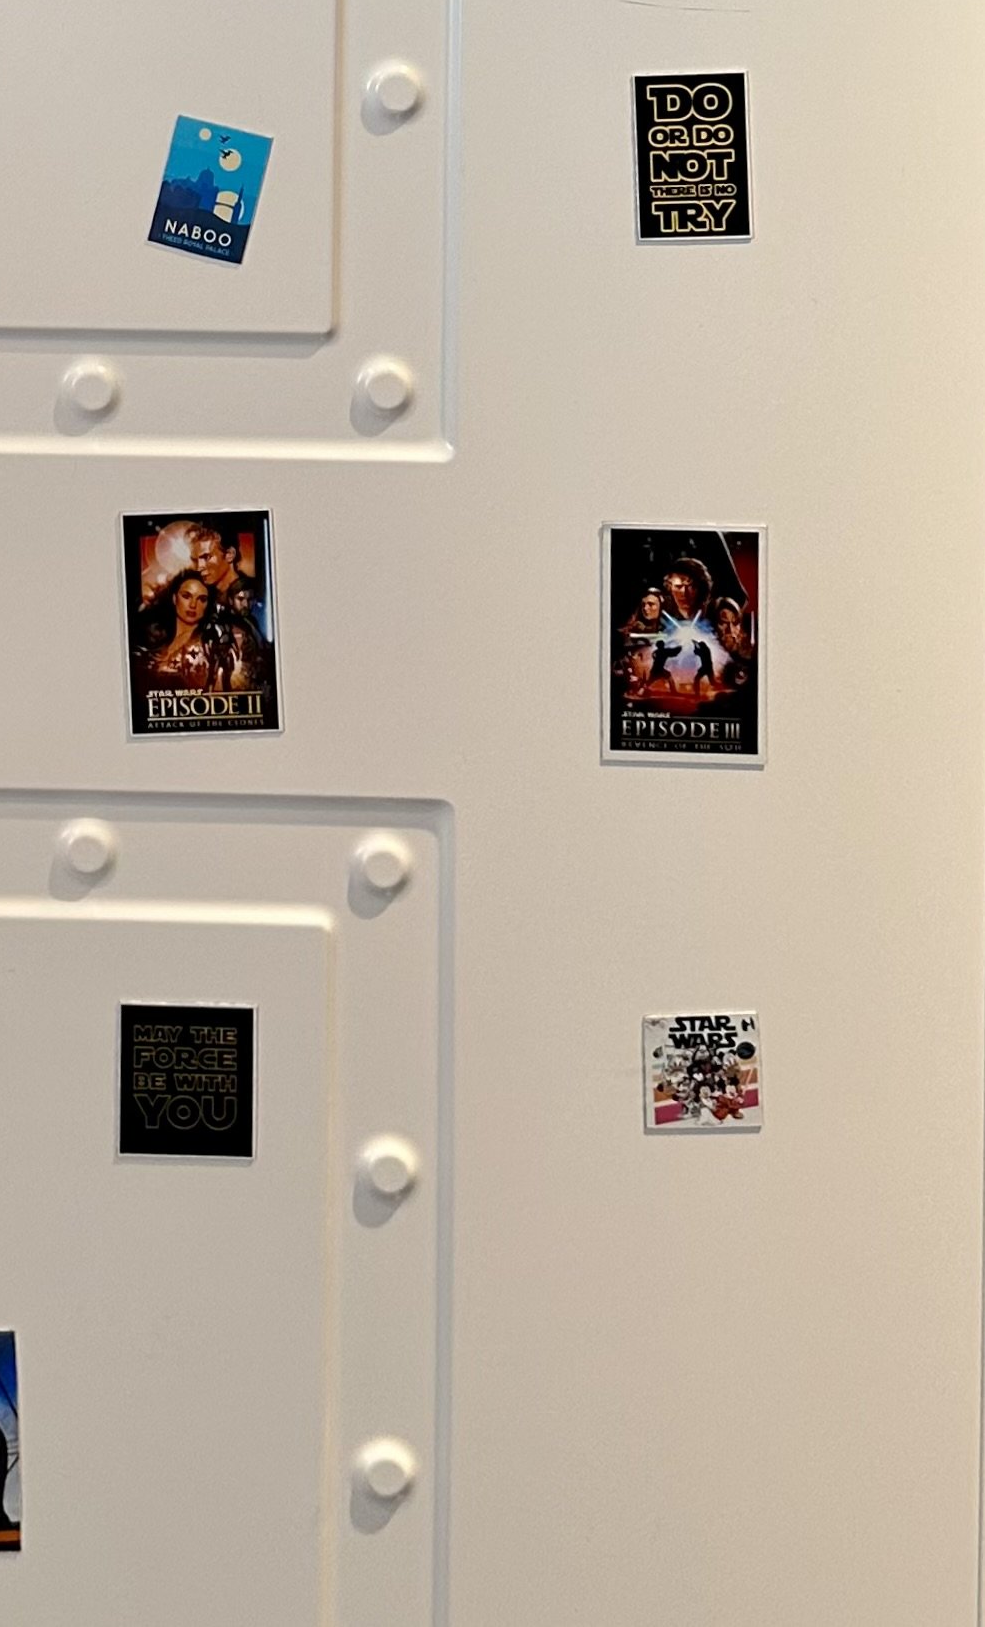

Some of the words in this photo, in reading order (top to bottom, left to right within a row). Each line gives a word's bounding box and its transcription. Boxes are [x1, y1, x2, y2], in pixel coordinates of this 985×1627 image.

[646, 82, 733, 122] DO
[648, 125, 689, 147] OR
[692, 124, 734, 146] DO
[649, 149, 735, 182] NOT
[650, 185, 697, 198] THERE
[698, 184, 712, 197] IS
[714, 183, 737, 197] NO
[651, 199, 736, 232] TRY
[164, 219, 232, 247] NABOO
[146, 690, 174, 698] STAR
[174, 689, 203, 697] WARS
[148, 696, 240, 718] EPISODE
[247, 695, 262, 714] II
[622, 720, 720, 739] EPISODE
[724, 722, 741, 740] III
[133, 1024, 183, 1043] MAY
[190, 1026, 237, 1045] THE
[669, 1015, 736, 1032] STAR
[668, 1032, 738, 1049] WARS
[133, 1046, 237, 1071] FORCE
[133, 1072, 166, 1090] BE
[173, 1073, 237, 1093] WITH
[133, 1093, 237, 1131] YOU
